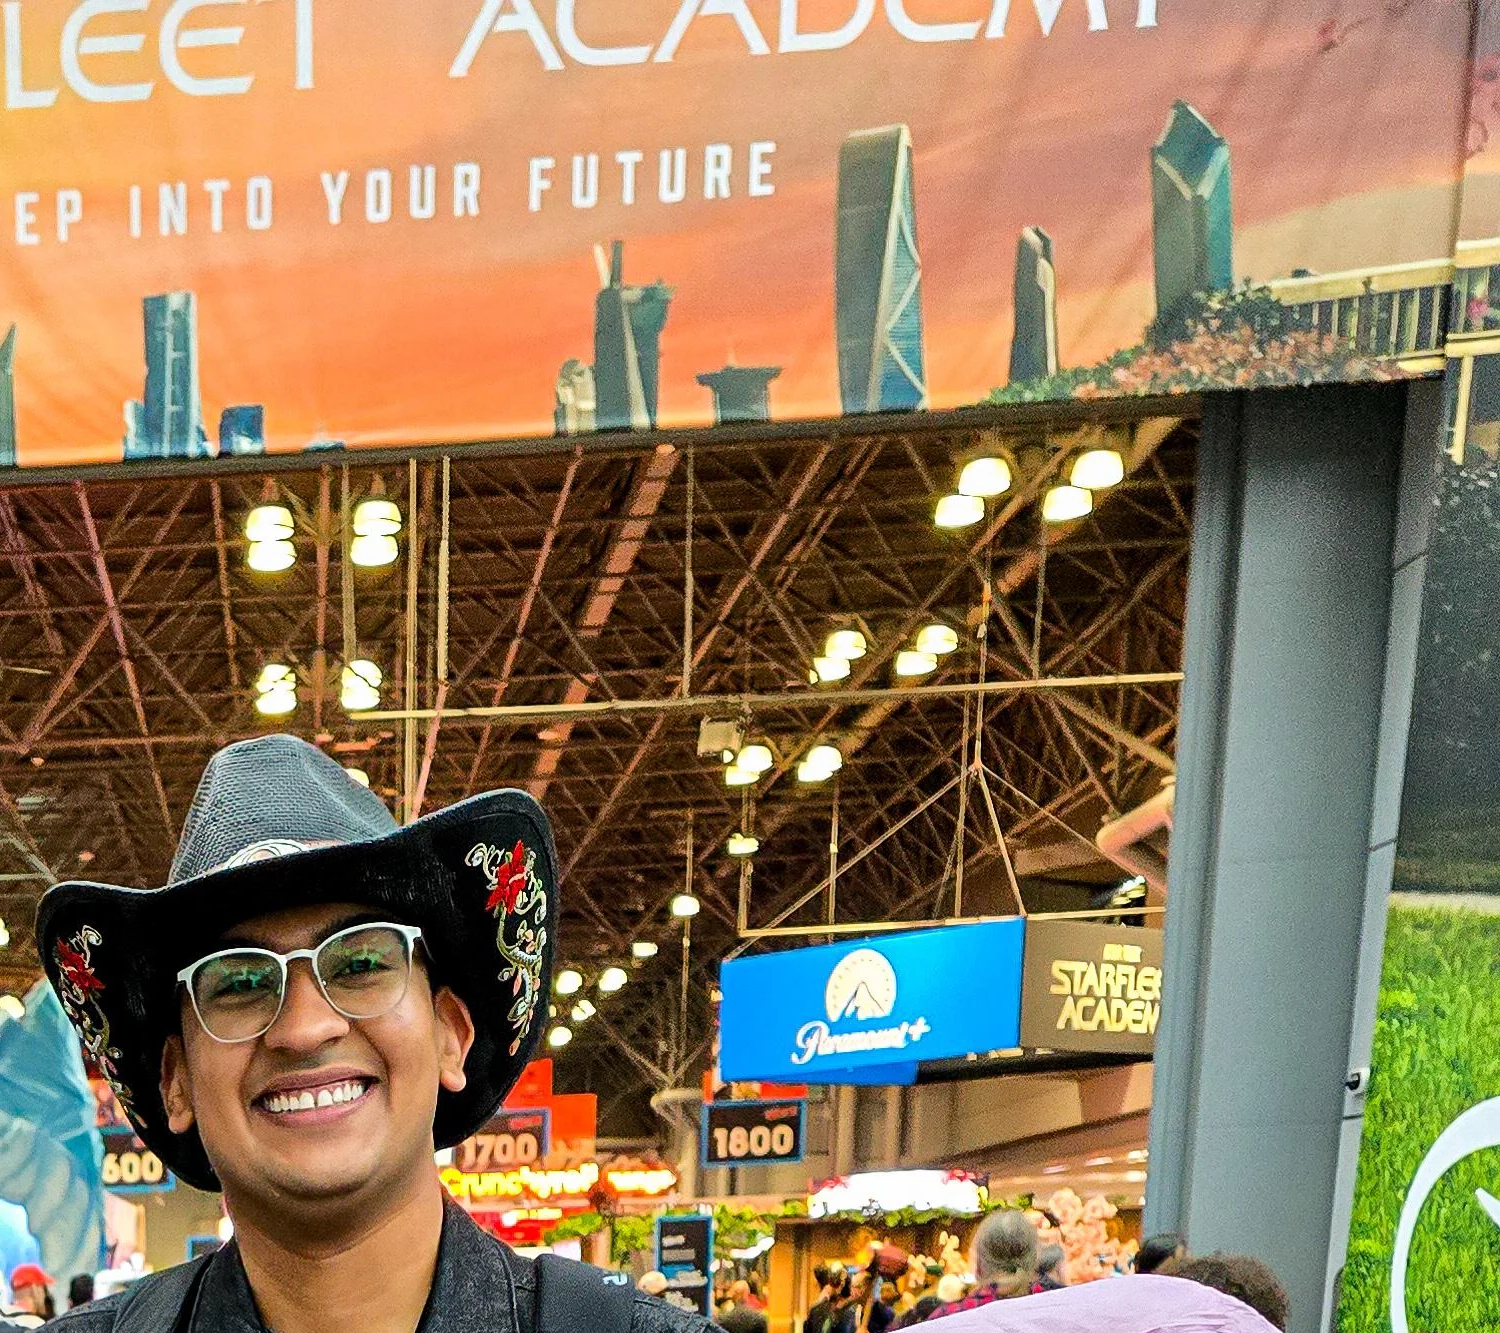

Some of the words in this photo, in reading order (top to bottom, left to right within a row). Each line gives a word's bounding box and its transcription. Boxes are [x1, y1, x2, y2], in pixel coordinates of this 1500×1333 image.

[128, 175, 274, 238] INTO
[320, 160, 482, 226] YOUR
[527, 140, 778, 213] FUTURE
[461, 1131, 538, 1166] 1700
[713, 1124, 794, 1158] 1800
